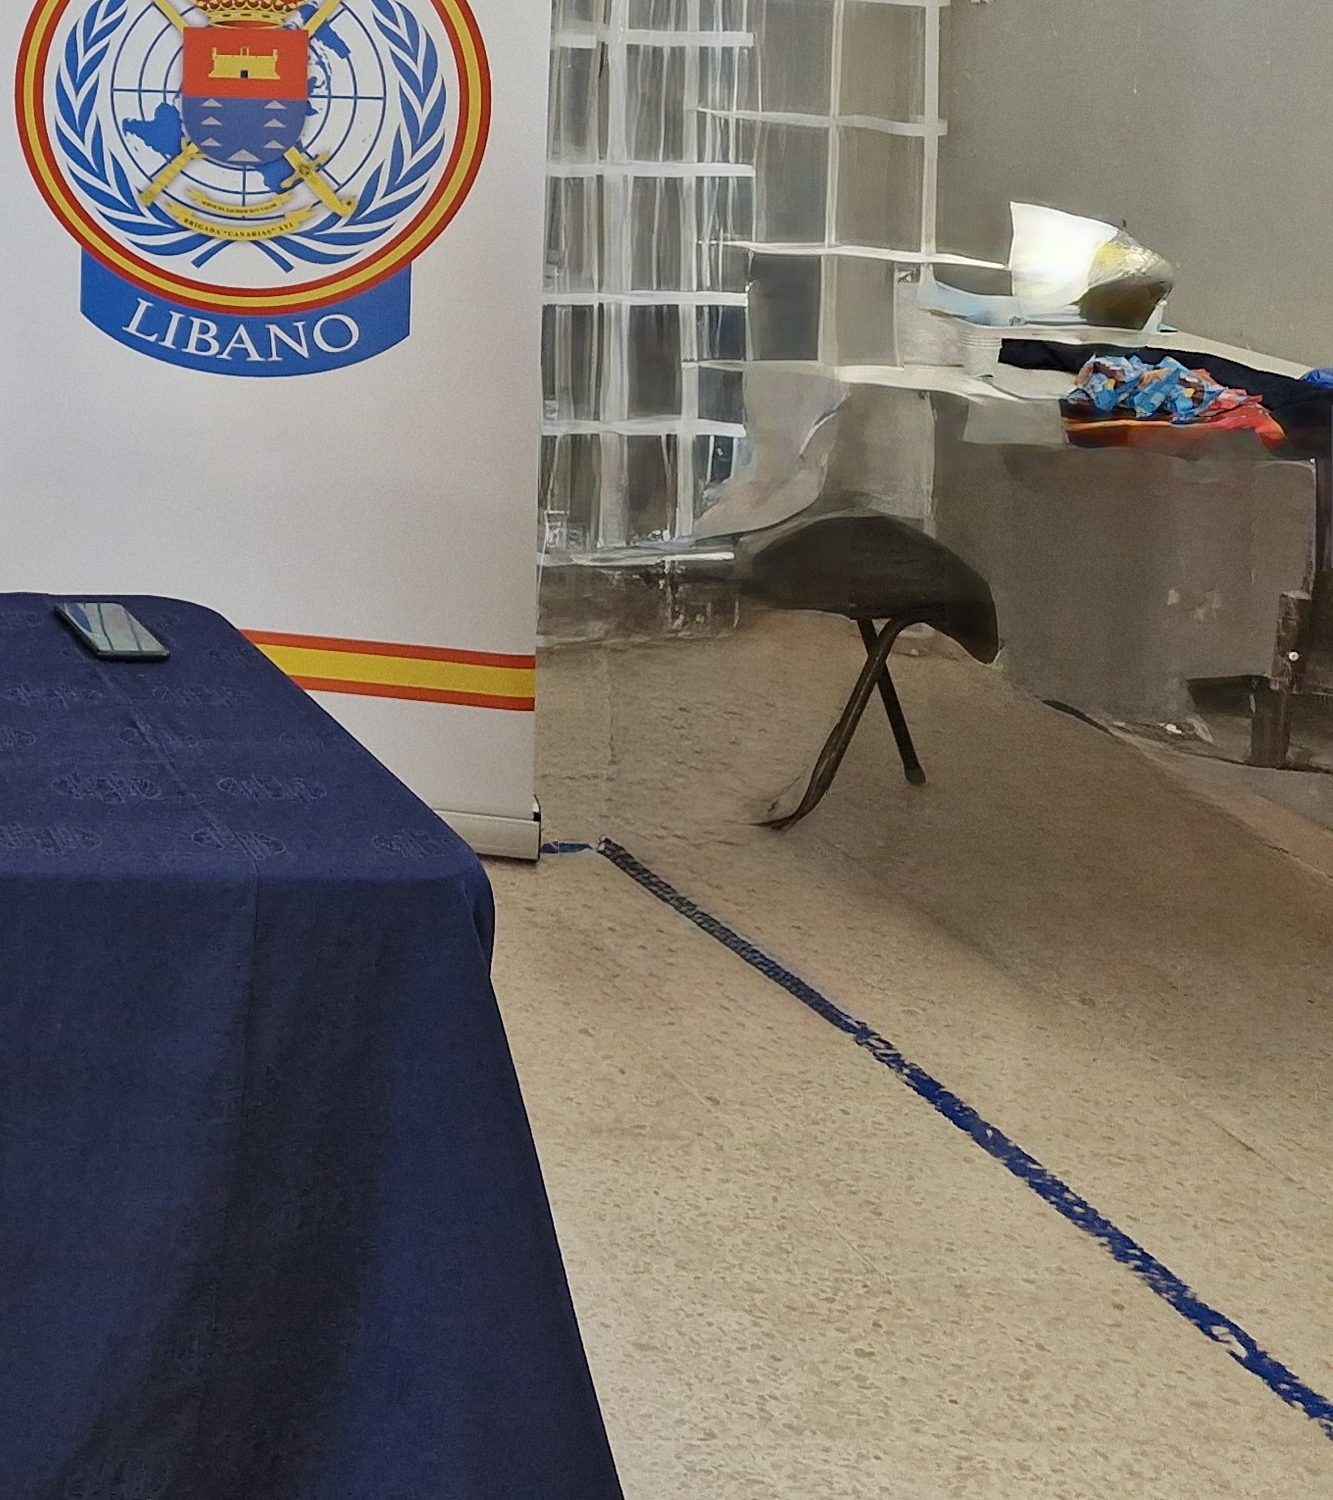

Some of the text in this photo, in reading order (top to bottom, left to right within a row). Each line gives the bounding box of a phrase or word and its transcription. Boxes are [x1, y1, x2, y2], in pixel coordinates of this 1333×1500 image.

[183, 217, 221, 236] BRIGADA
[278, 221, 294, 233] XVI
[121, 297, 360, 362] LIBANO
